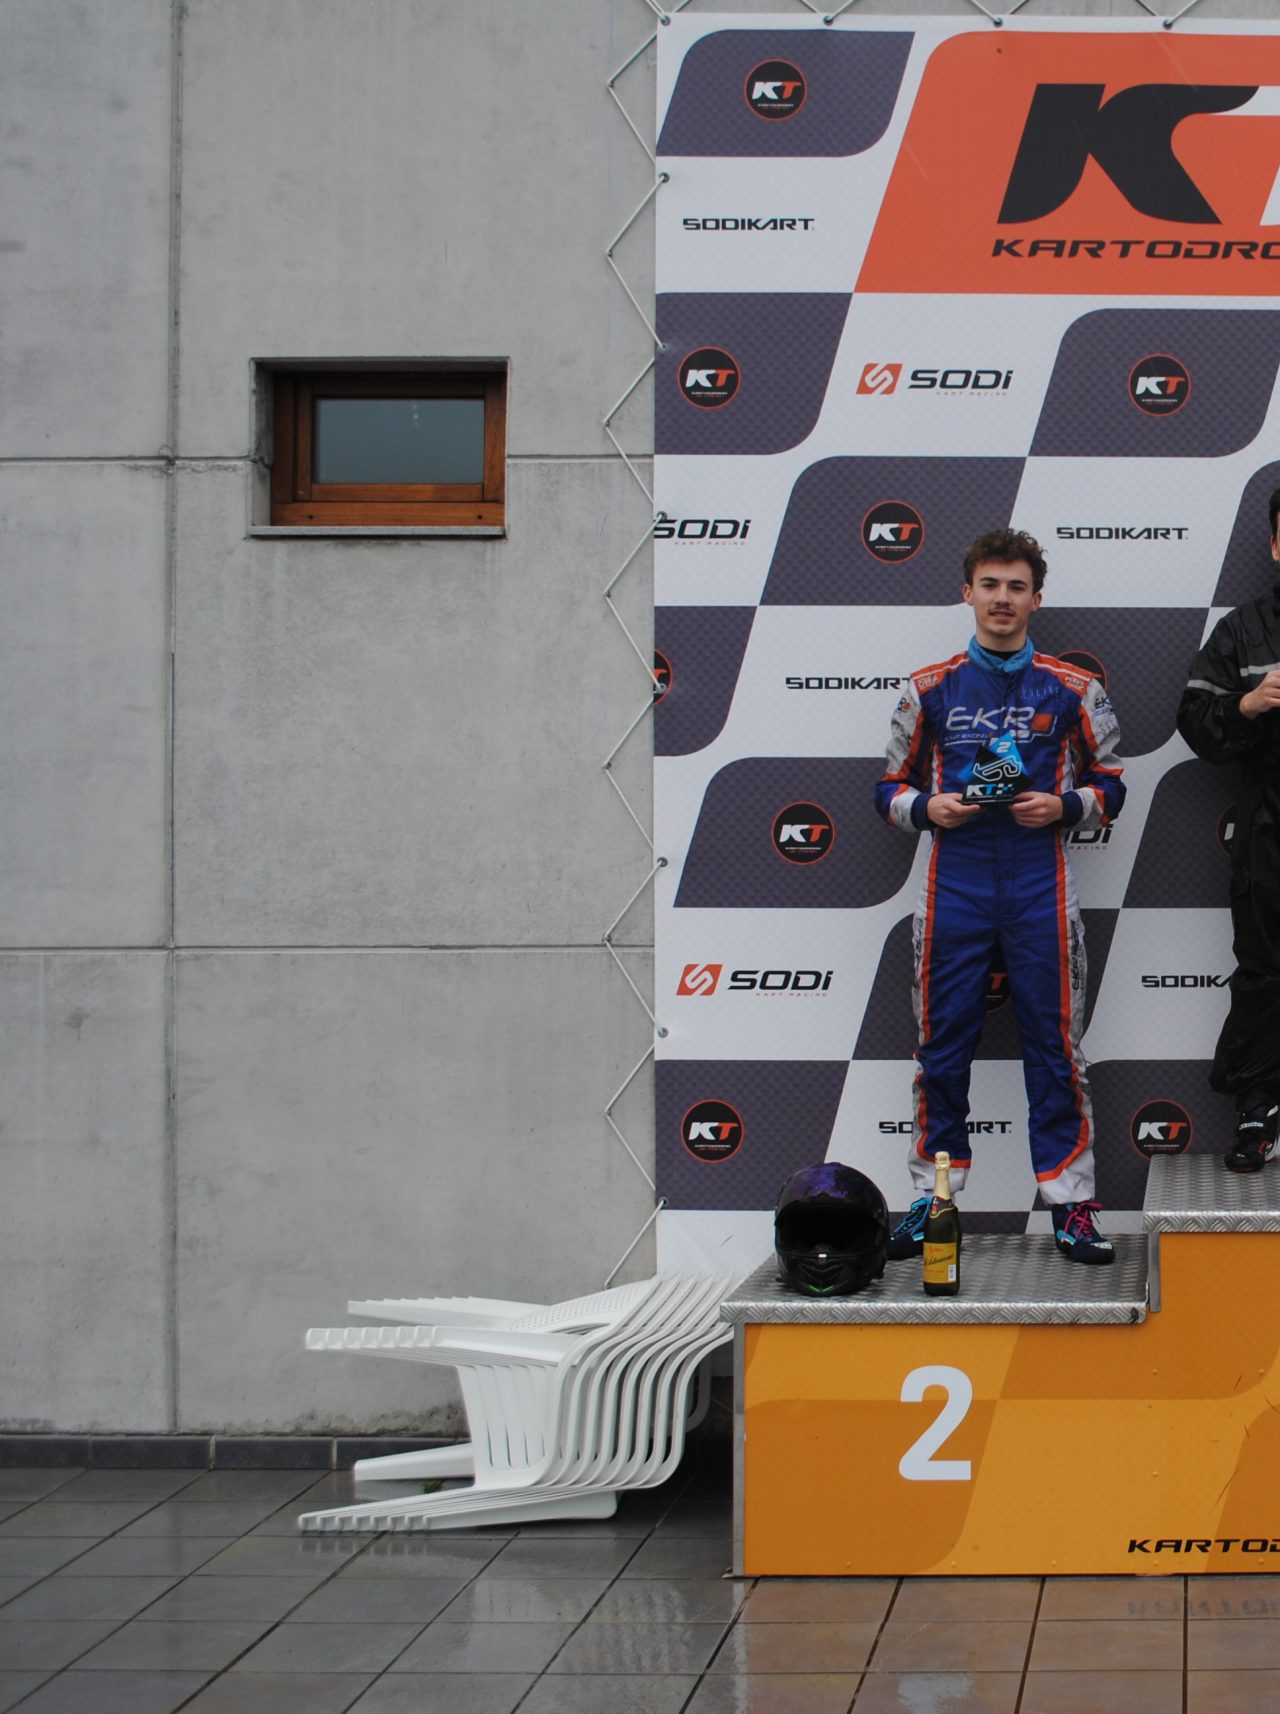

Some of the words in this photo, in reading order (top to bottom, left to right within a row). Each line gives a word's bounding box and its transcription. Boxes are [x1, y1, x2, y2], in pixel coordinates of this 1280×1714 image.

[752, 81, 801, 100] KT
[683, 217, 815, 231] SODIKART
[685, 368, 735, 388] KT
[1135, 376, 1184, 395] KT
[869, 523, 918, 542] KT
[1056, 526, 1189, 541] SODIKART
[946, 706, 1035, 731] EKR
[996, 741, 1011, 753] 2
[779, 824, 829, 843] KT
[989, 972, 1008, 990] T
[689, 1122, 738, 1141] KT
[1138, 1121, 1186, 1141] KT
[898, 1365, 973, 1482] 2
